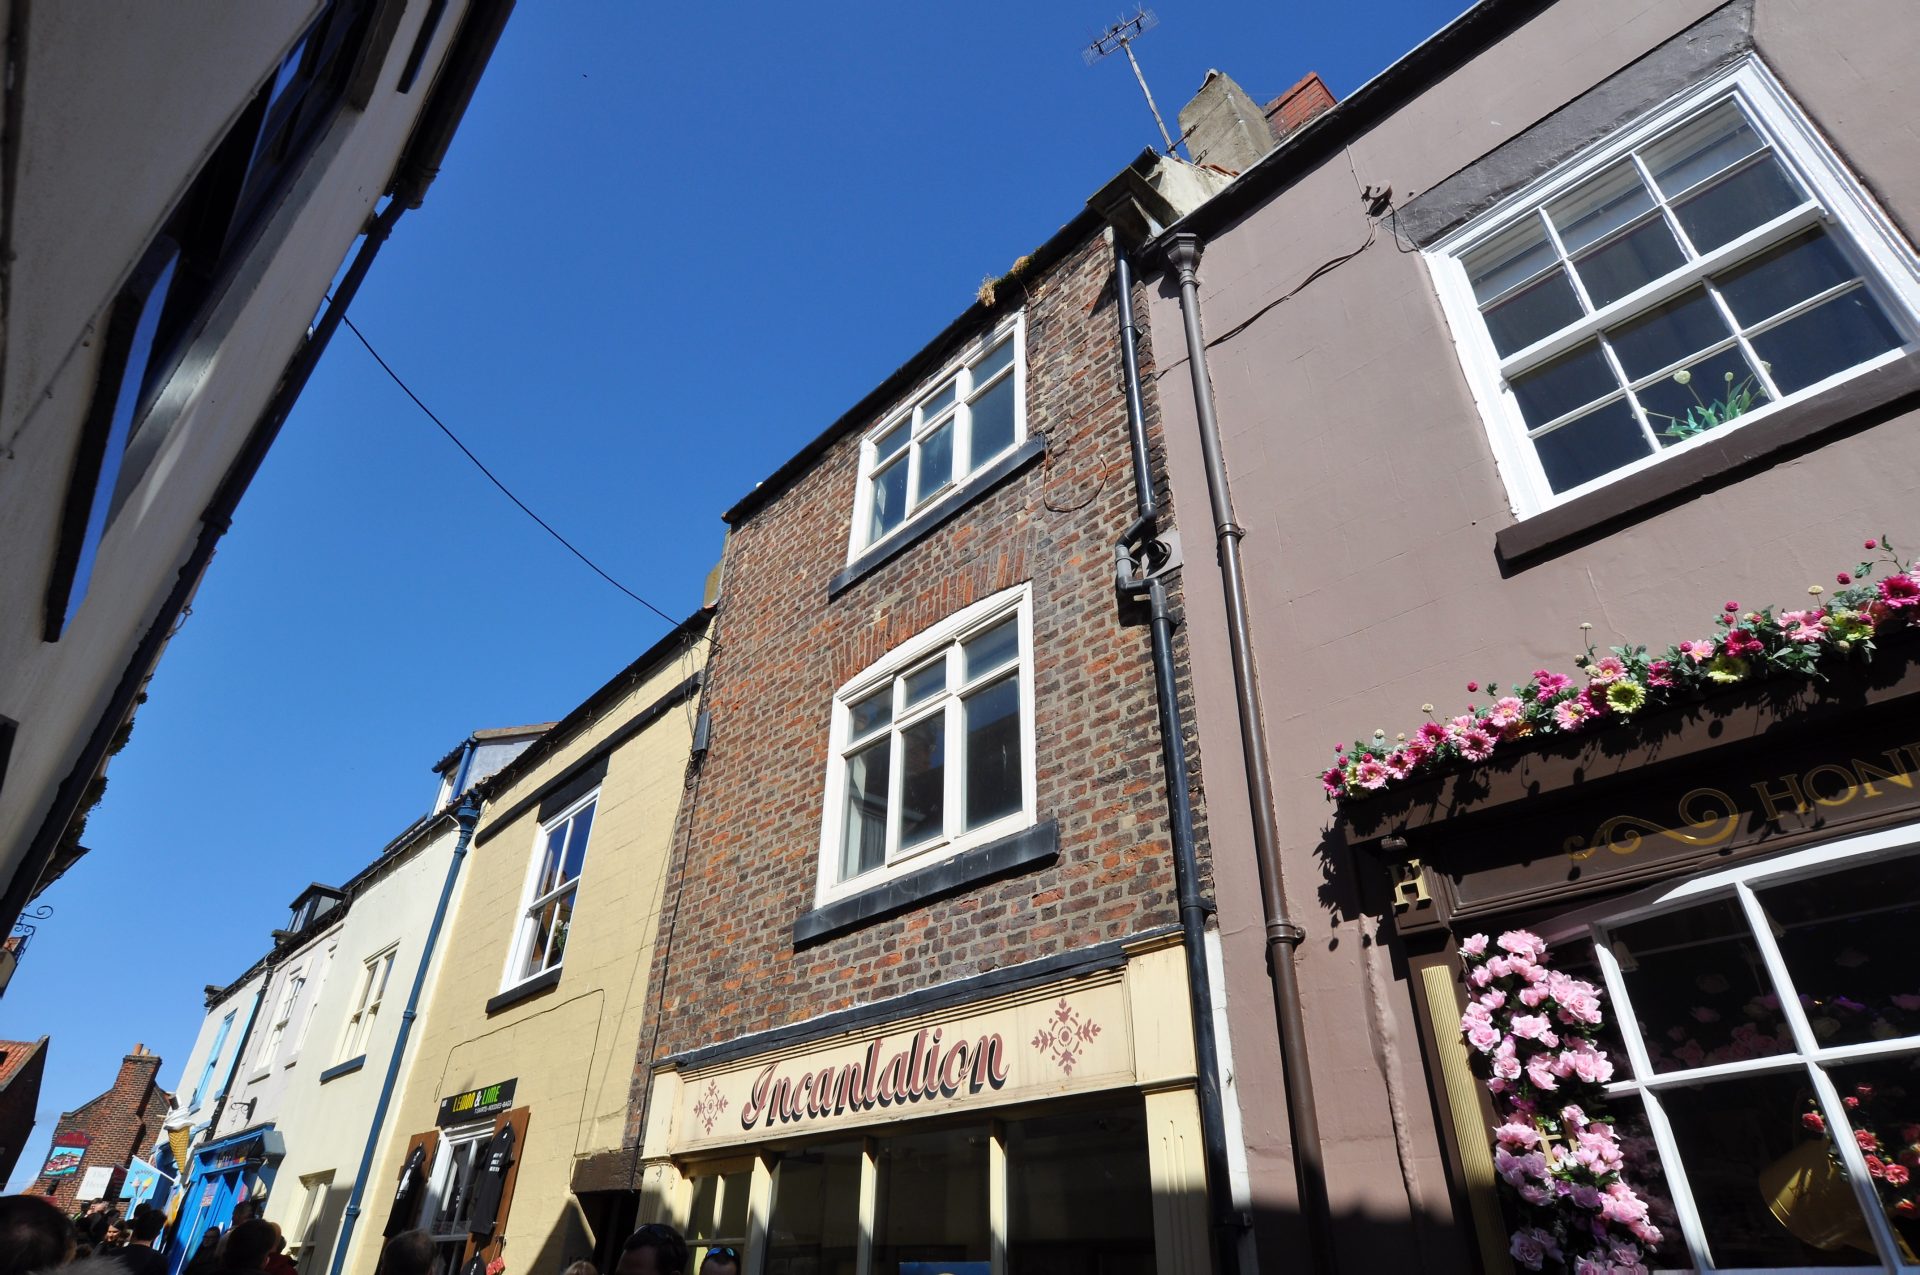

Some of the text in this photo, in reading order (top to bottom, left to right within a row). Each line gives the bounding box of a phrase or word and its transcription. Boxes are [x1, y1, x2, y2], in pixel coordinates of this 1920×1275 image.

[452, 1091, 476, 1113] LEMON
[474, 1090, 482, 1108] &
[481, 1085, 501, 1106] LIME
[740, 1027, 1010, 1131] Incantation
